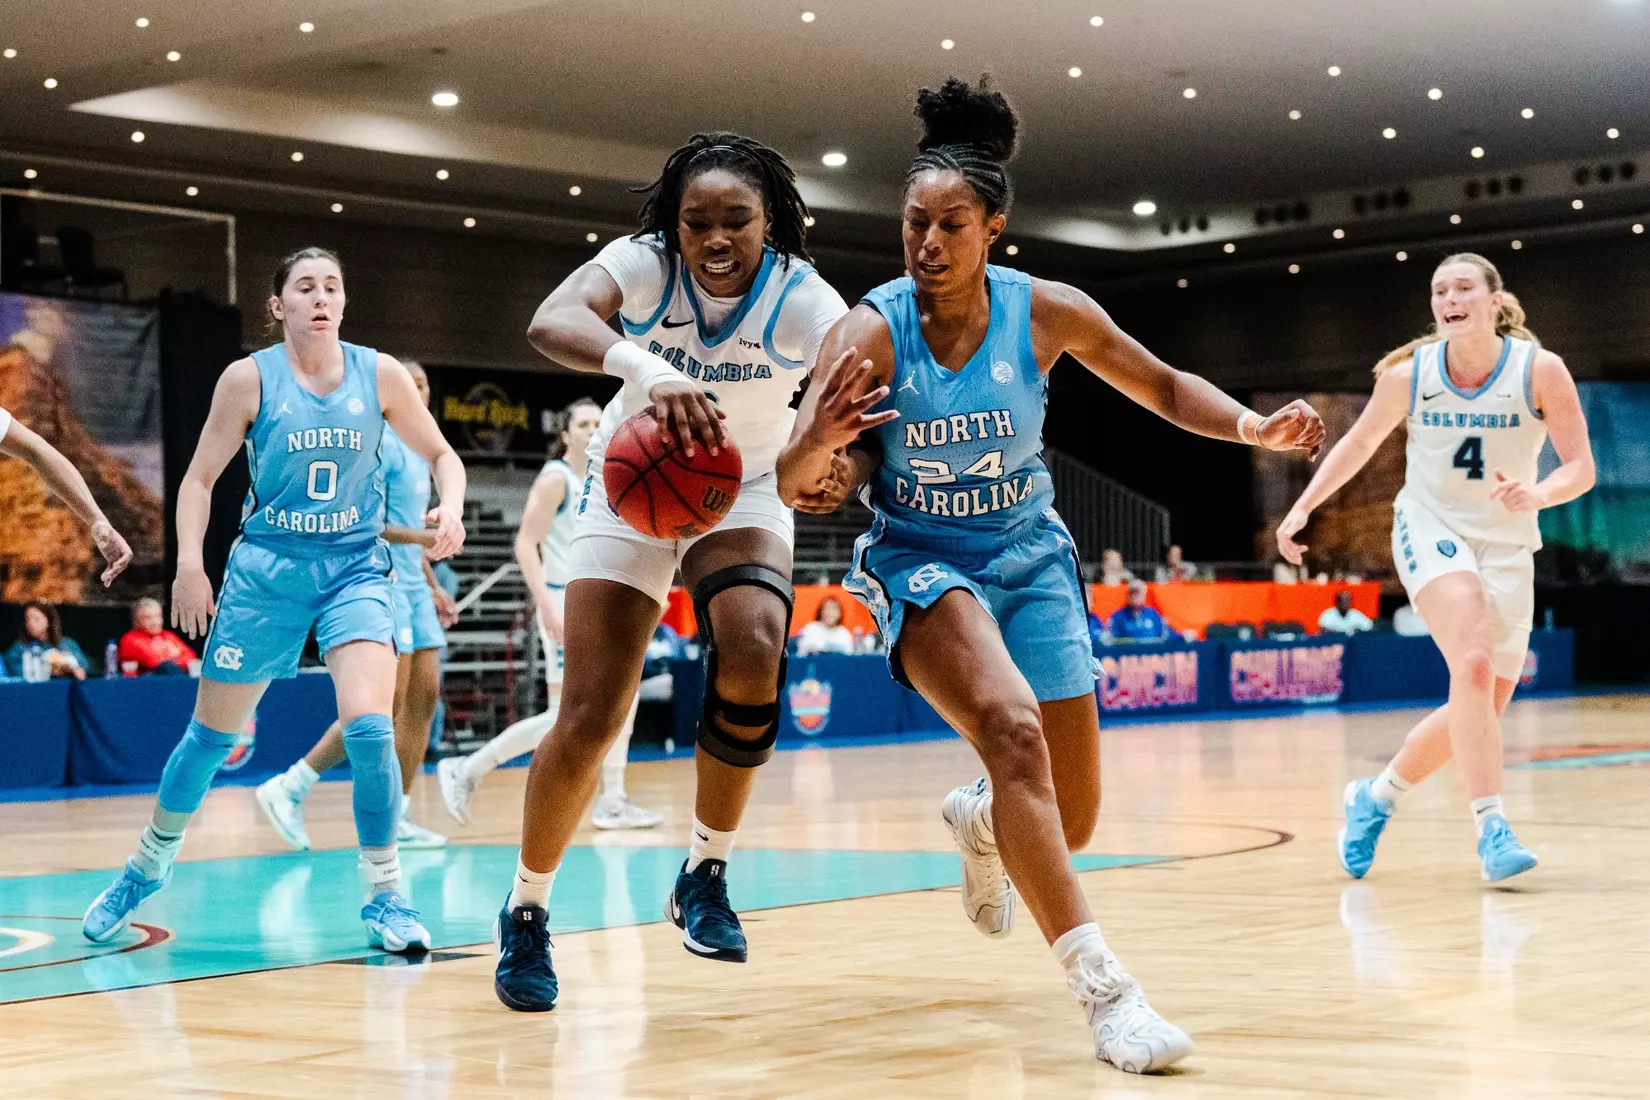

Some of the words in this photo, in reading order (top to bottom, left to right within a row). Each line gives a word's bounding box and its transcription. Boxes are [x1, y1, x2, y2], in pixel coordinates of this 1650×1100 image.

[738, 336, 754, 349] Ivy
[904, 409, 1016, 449] NORTH
[1421, 411, 1521, 429] COLUMBIA
[287, 427, 363, 453] NORTH
[1452, 436, 1485, 480] 4
[306, 459, 339, 502] 0
[895, 472, 1034, 518] CAROLINA
[264, 504, 361, 534] CAROLINA
